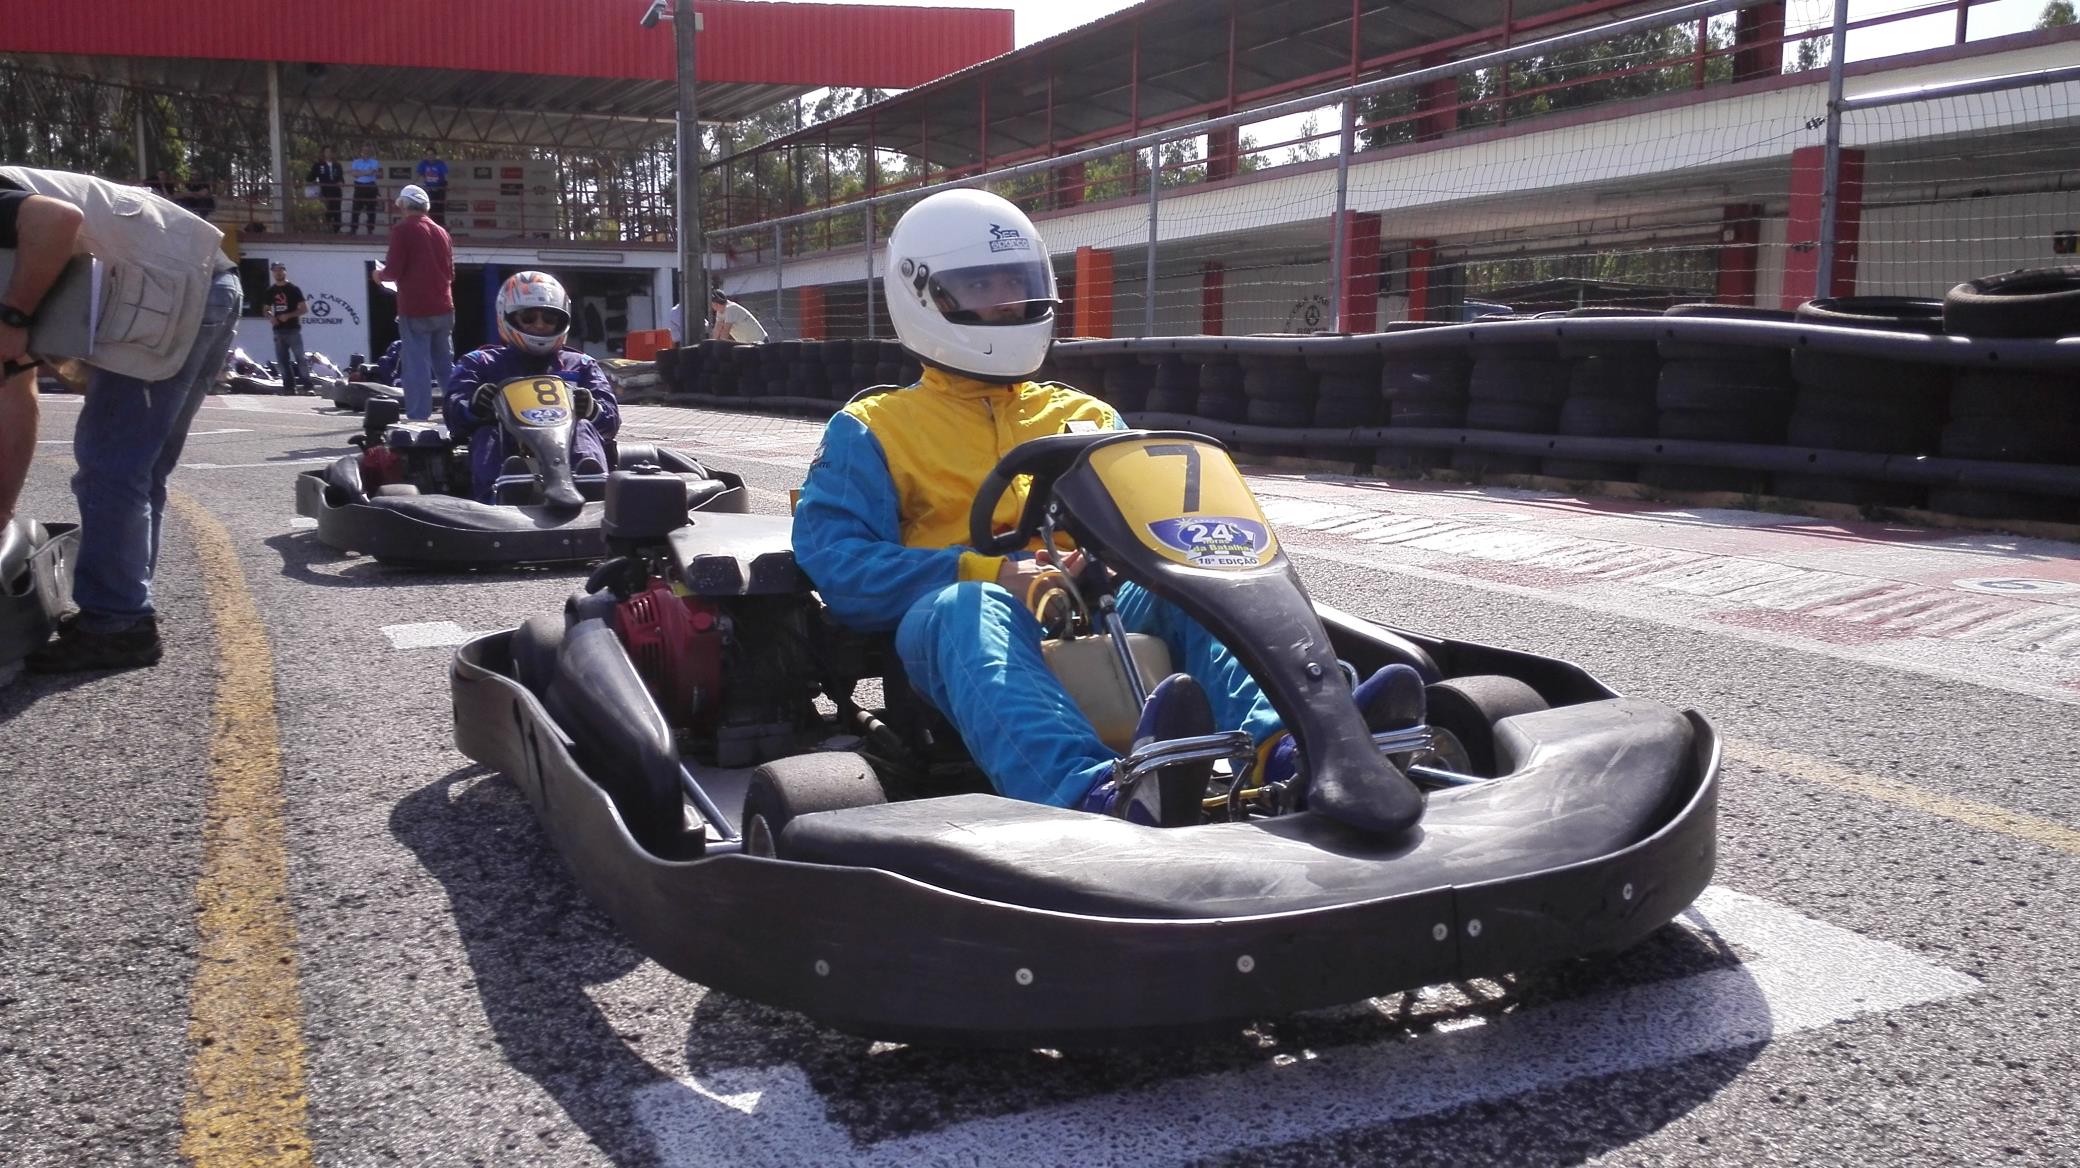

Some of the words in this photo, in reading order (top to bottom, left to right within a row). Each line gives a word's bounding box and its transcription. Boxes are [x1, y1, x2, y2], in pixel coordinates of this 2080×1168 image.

[533, 380, 561, 405] 8
[1143, 444, 1200, 513] 7
[1187, 524, 1234, 543] 24
